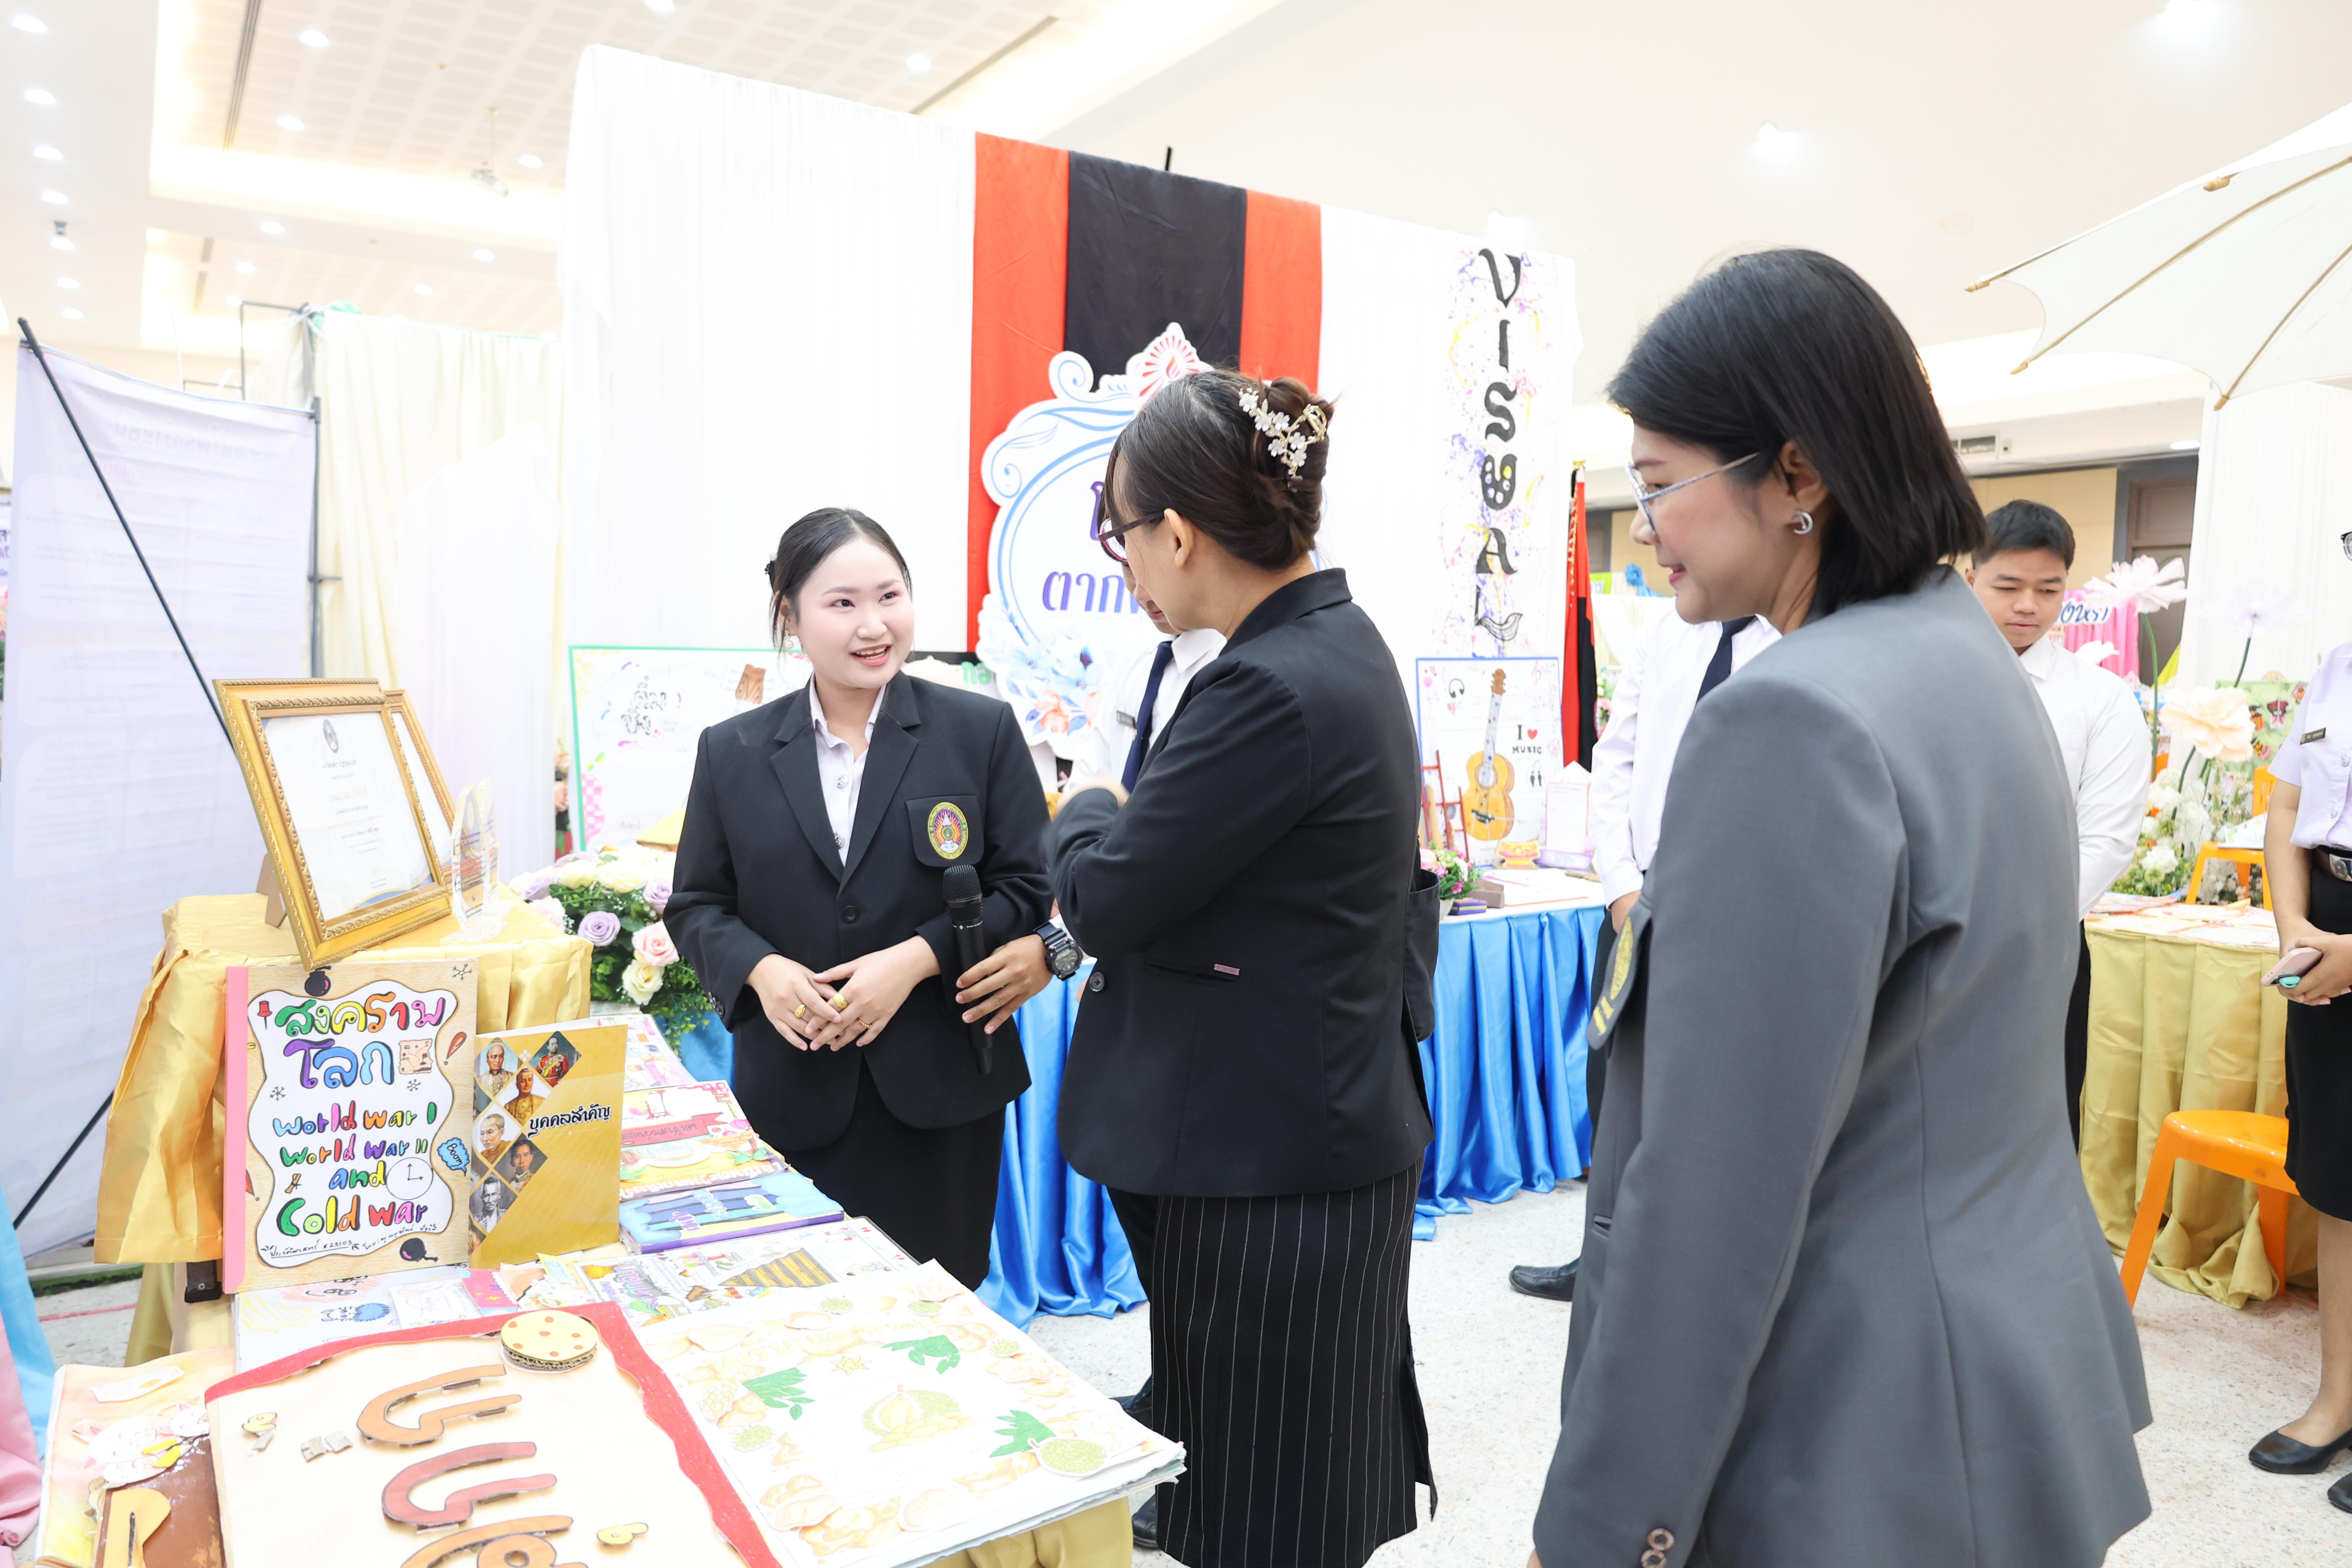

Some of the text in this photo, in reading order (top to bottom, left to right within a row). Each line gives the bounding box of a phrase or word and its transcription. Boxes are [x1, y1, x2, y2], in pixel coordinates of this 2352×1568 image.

[1475, 248, 1523, 641] VISUAL
[1512, 746, 1542, 754] MUSIC
[282, 1037, 394, 1091] โลก
[528, 1103, 612, 1138] บุคคลสำคัญ
[329, 1160, 387, 1190] and
[277, 1195, 360, 1236] Cold
[270, 1239, 321, 1257] ประวัติศาสตร์
